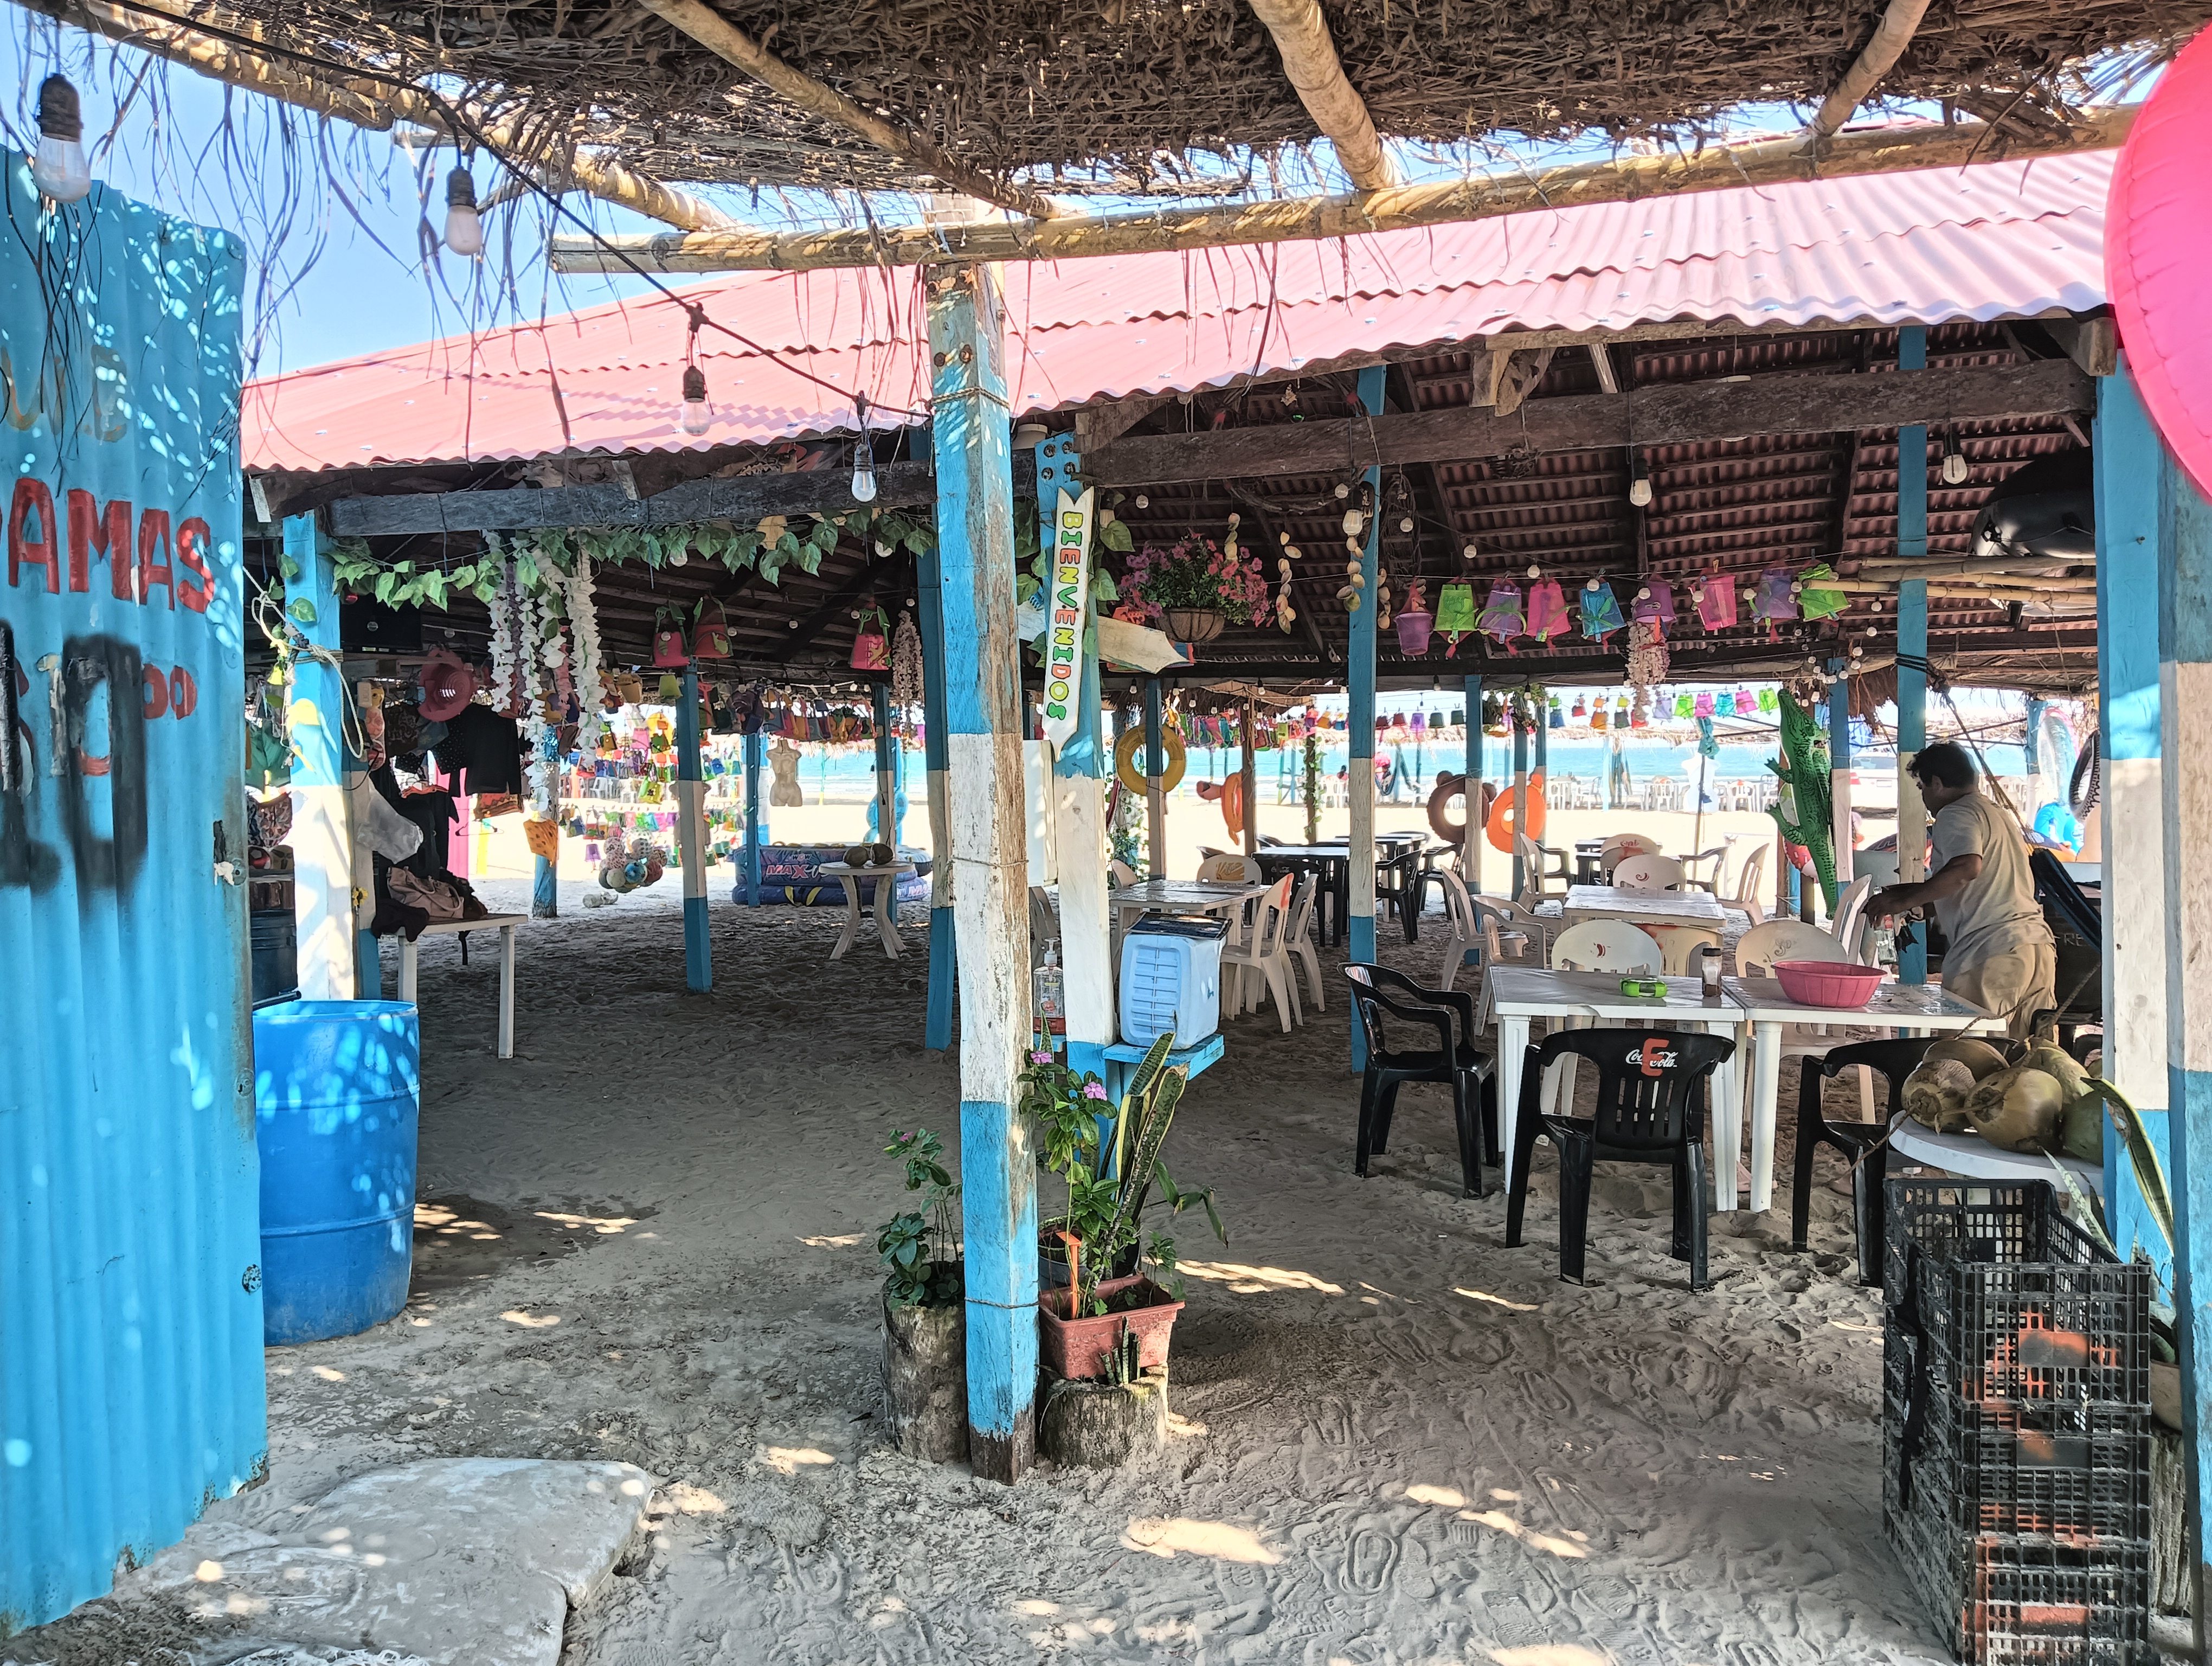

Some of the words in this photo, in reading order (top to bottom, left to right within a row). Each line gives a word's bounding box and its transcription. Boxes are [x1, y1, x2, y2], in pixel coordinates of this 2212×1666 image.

[0, 478, 215, 613] AMAS
[1046, 511, 1084, 721] BIENVENIDOS
[767, 864, 809, 878] MAX
[792, 853, 812, 861] WOW
